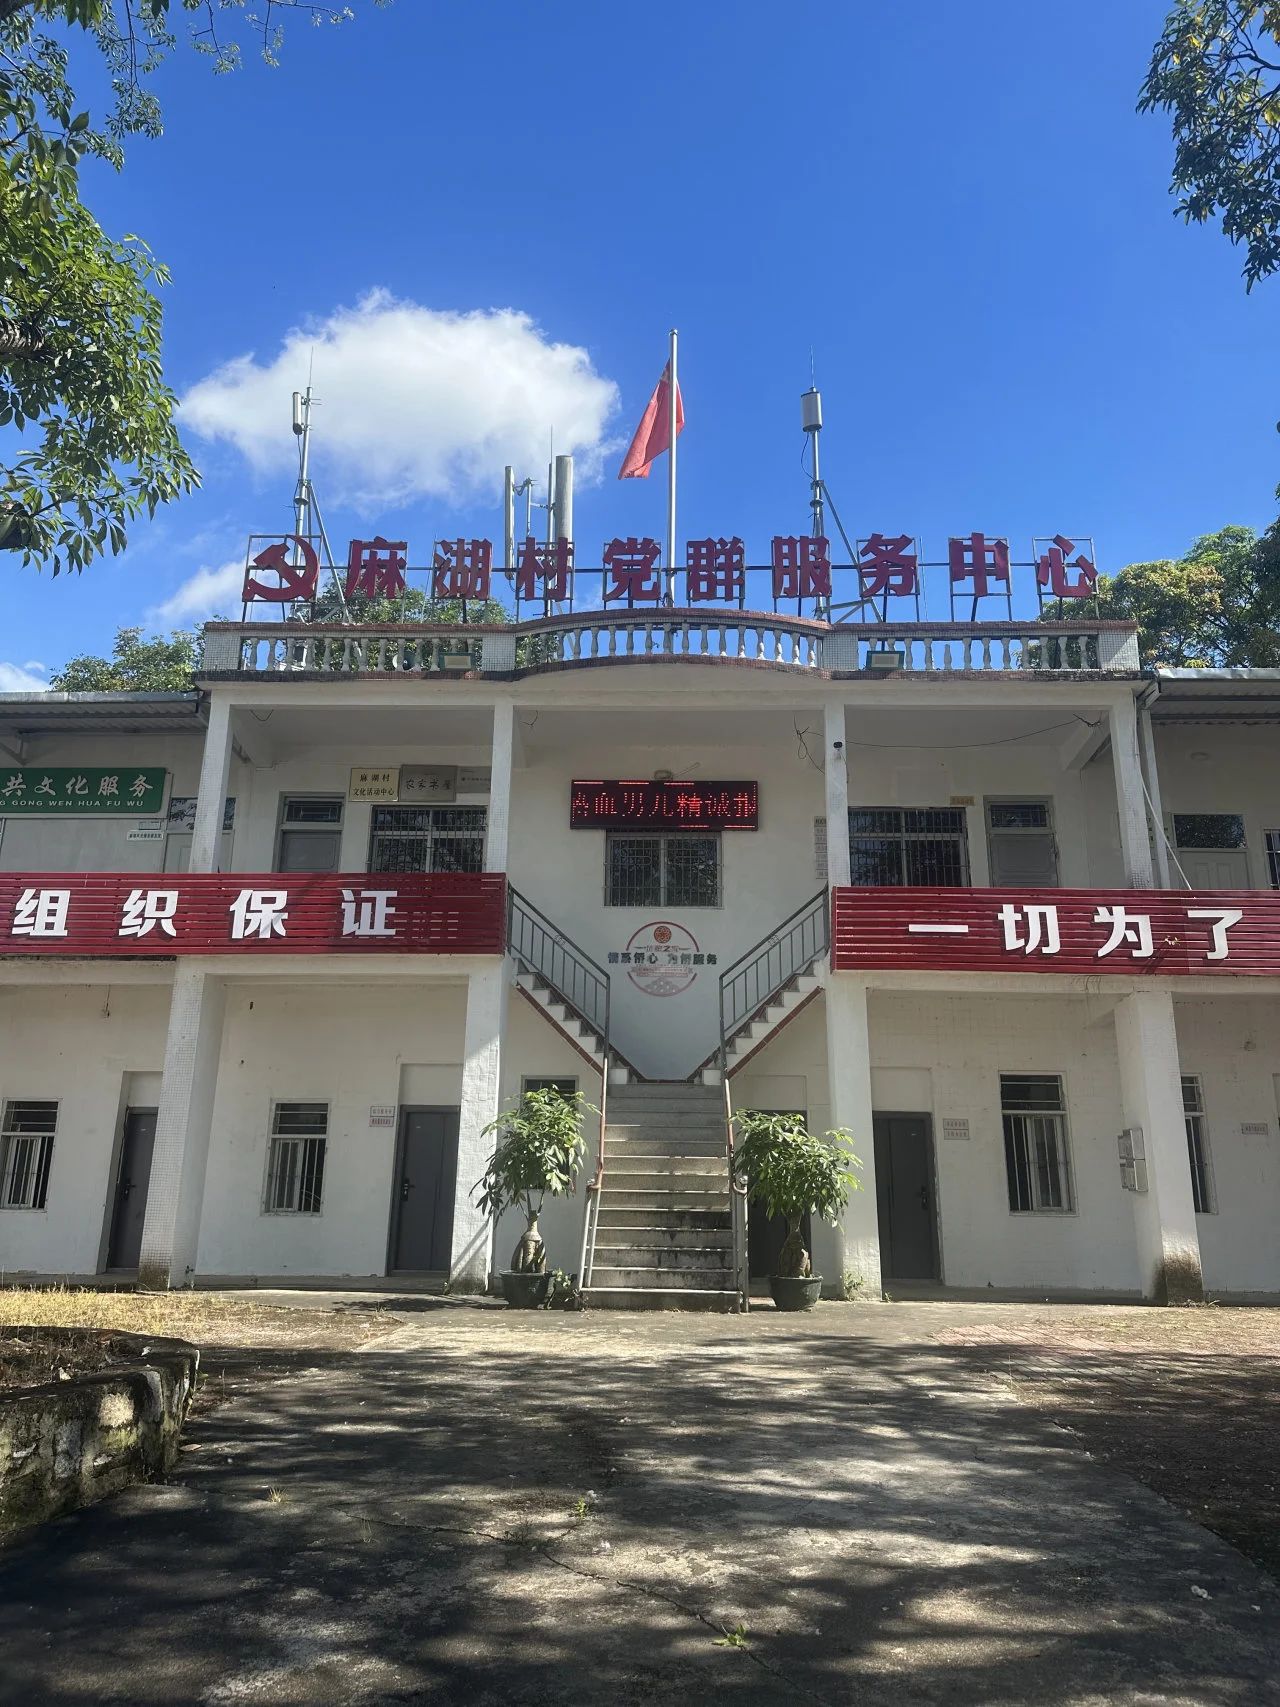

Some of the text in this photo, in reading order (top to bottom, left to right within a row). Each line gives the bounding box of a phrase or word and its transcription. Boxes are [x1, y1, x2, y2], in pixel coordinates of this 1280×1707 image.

[345, 533, 1099, 601] 麻湖村党群服务中心
[2, 773, 153, 797] 共文化服务
[352, 787, 395, 796] 文化活动中心
[360, 773, 390, 782] 麻湖村
[11, 888, 398, 939] 组织保证
[908, 904, 1243, 960] 一切为了
